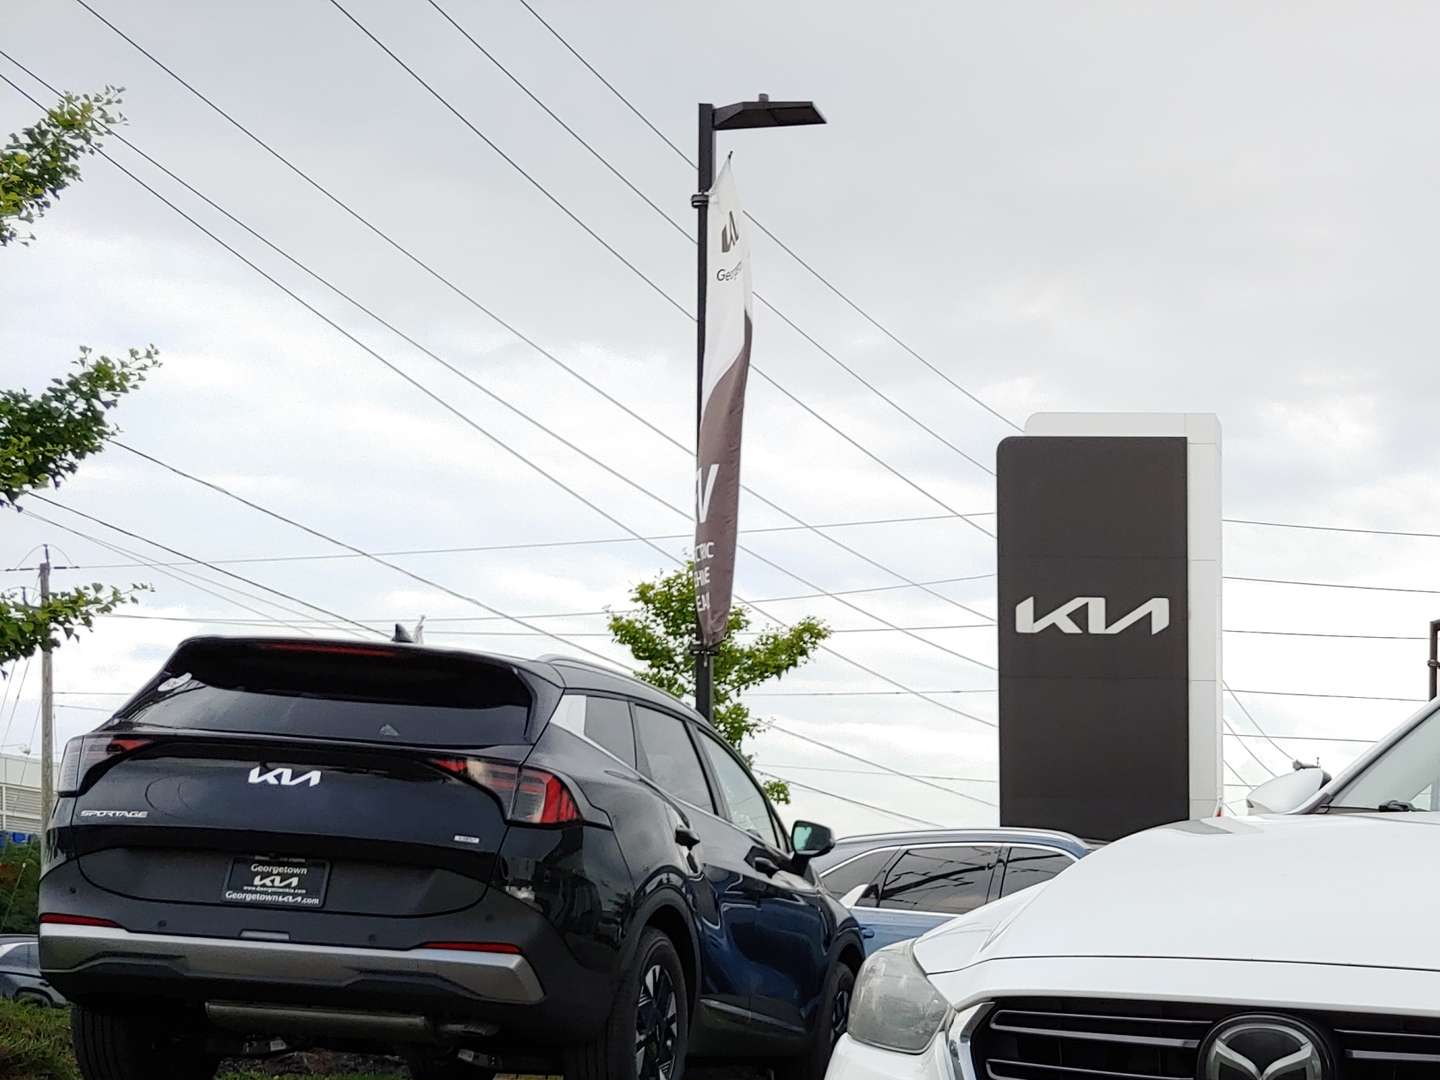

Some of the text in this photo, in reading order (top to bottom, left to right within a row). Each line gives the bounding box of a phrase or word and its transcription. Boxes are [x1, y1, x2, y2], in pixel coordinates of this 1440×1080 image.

[1015, 596, 1170, 636] KIA
[248, 766, 321, 787] KIA
[80, 810, 149, 818] SPORTAGE
[250, 863, 308, 875] Georgetown
[253, 875, 299, 888] KIA
